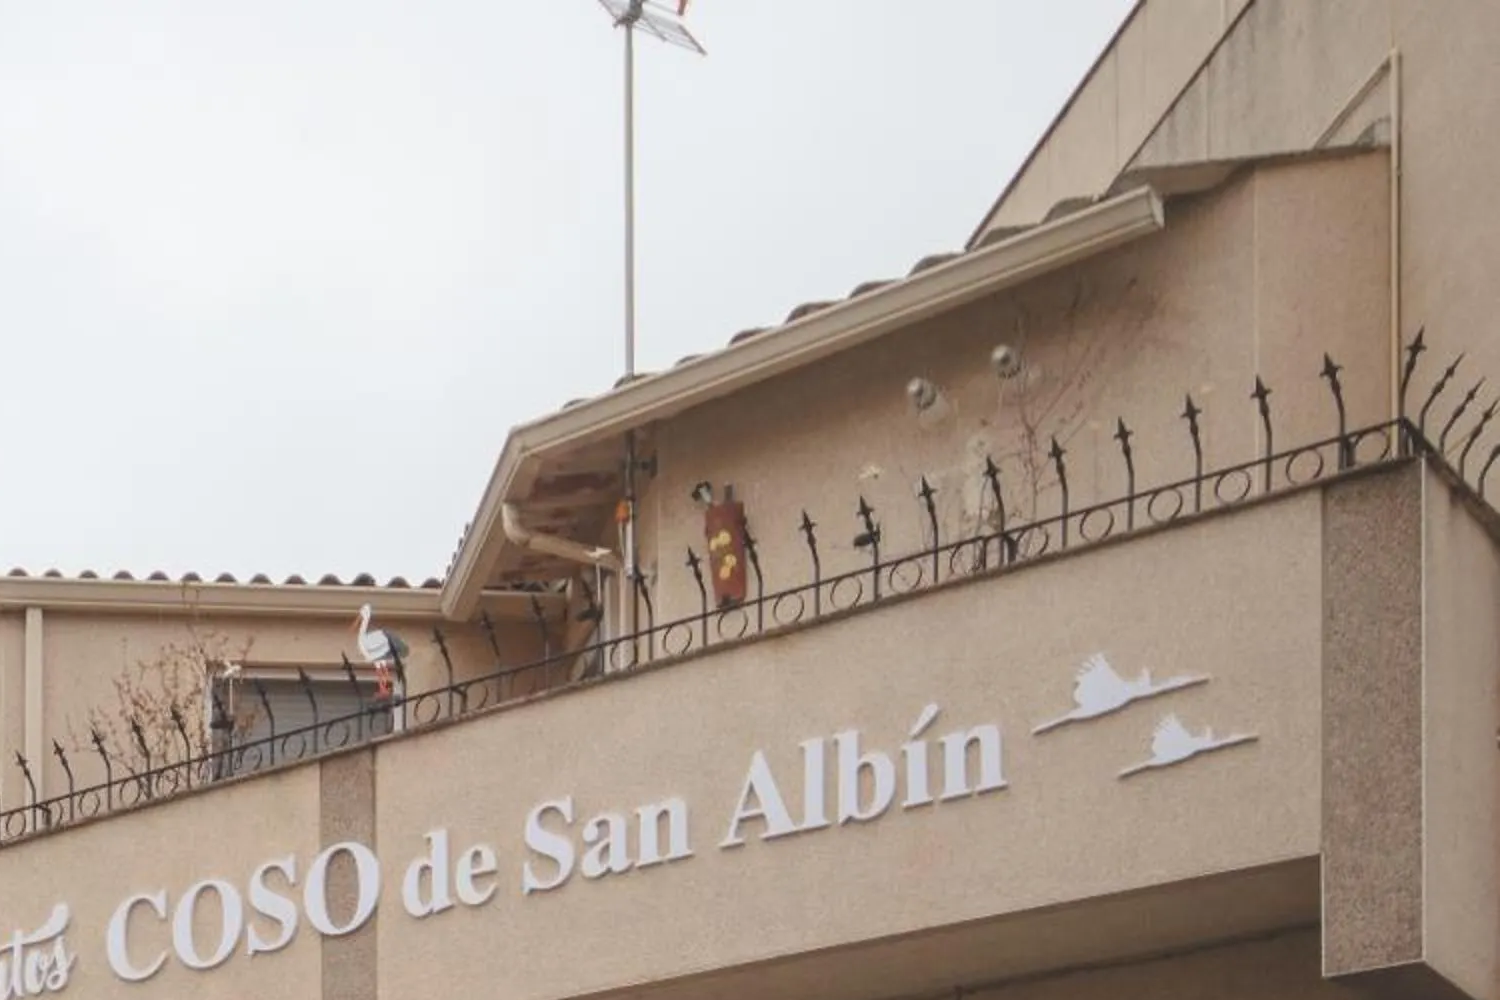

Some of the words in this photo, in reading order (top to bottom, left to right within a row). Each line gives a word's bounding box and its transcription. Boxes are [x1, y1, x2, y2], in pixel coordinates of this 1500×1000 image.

[106, 840, 380, 982] COSO
[402, 829, 497, 917] de
[522, 794, 695, 895] San
[719, 702, 1009, 848] Albín
